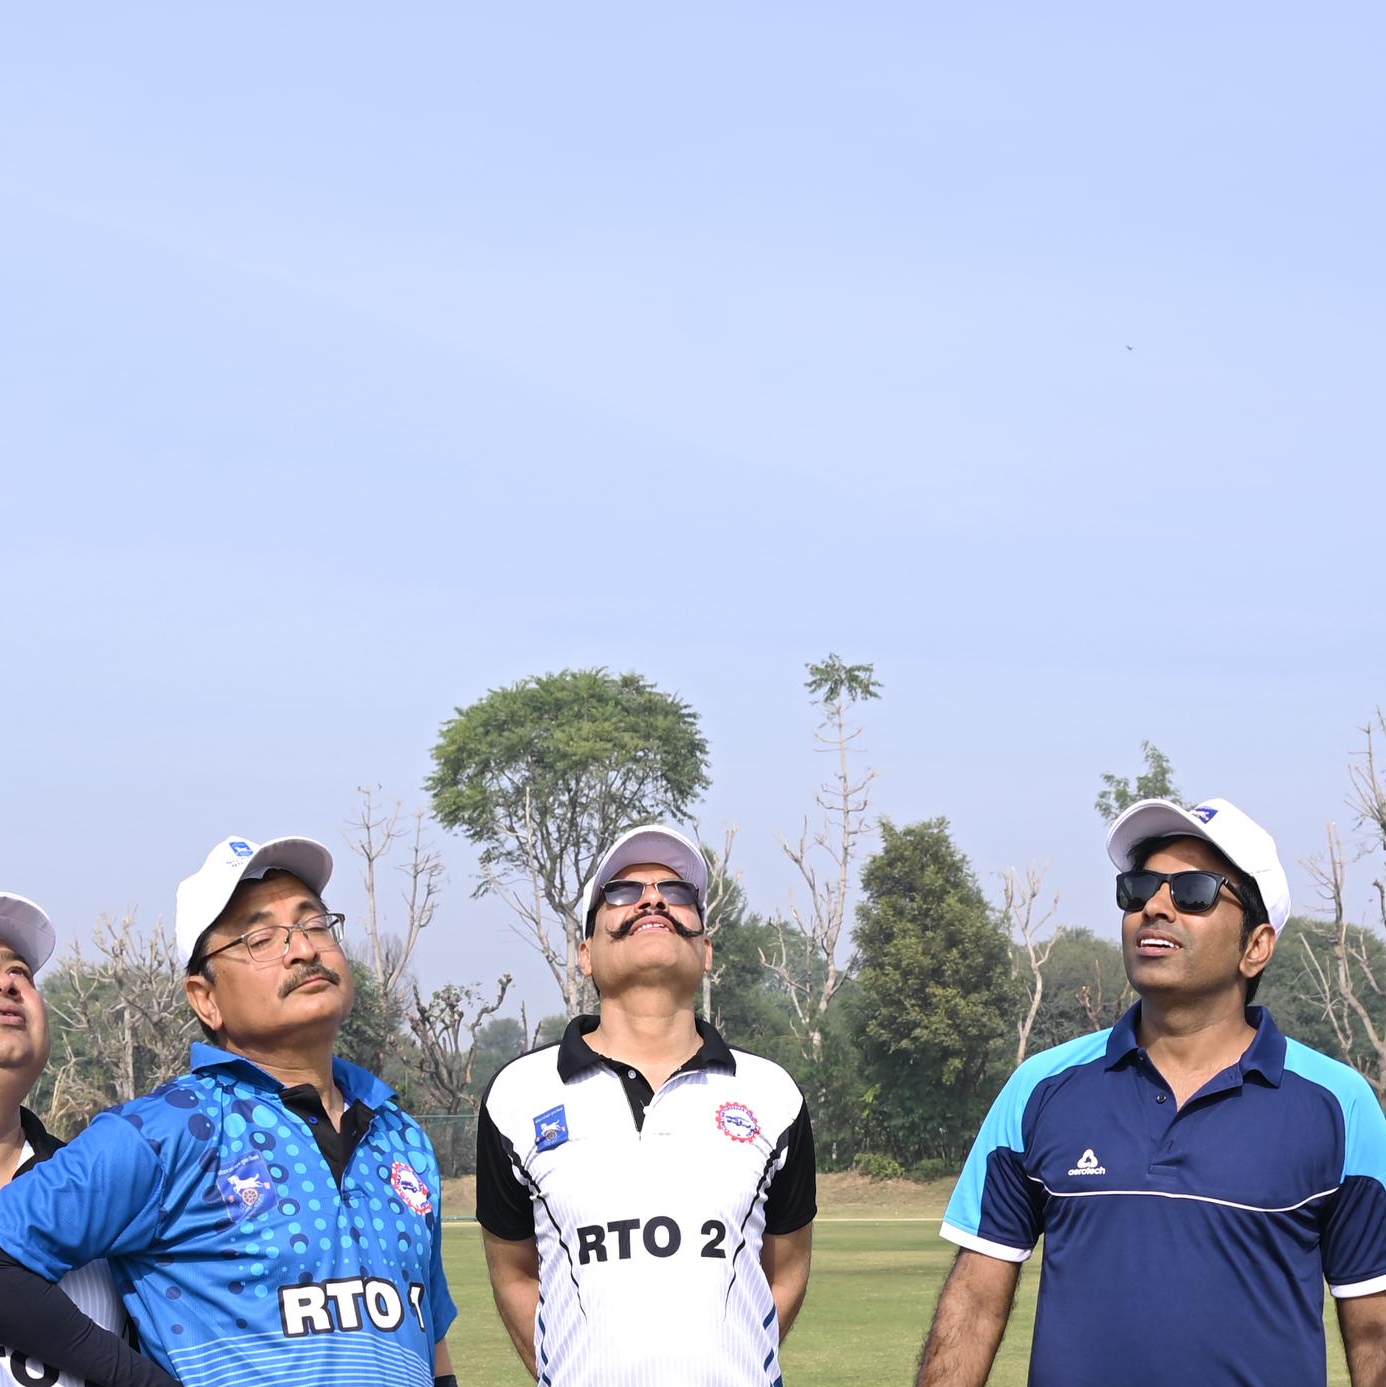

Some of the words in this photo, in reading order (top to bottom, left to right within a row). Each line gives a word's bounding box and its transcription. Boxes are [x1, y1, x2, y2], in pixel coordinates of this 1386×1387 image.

[1068, 1166, 1106, 1176] aerotech
[577, 1216, 681, 1265] RTO
[701, 1219, 726, 1259] 2
[277, 1276, 404, 1338] RTO
[409, 1281, 426, 1333] 1
